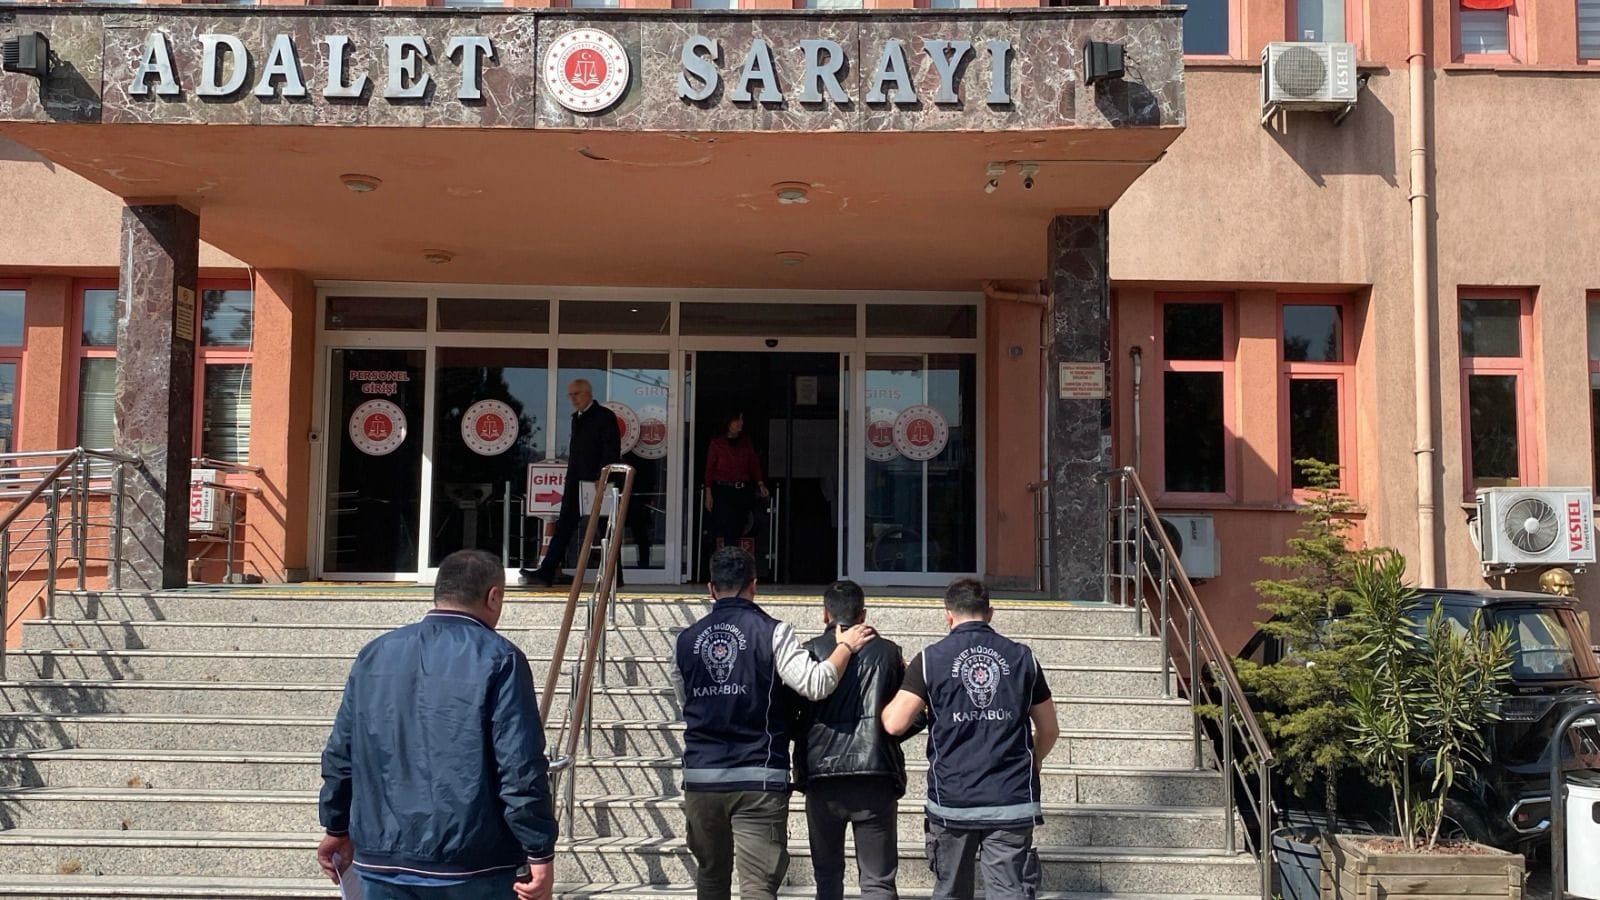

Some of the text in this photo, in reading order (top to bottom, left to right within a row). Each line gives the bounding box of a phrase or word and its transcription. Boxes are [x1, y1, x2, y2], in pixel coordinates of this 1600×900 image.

[128, 32, 1011, 103] ADALET SARAYI
[1336, 48, 1349, 94] VESTEL
[350, 370, 410, 381] PERSONEL
[361, 382, 398, 396] GİRİŞİ
[1568, 498, 1582, 552] VESTEL
[693, 626, 713, 654] EMNİYET
[693, 683, 747, 697] KARABÜK
[953, 708, 1013, 722] KARABÜK
